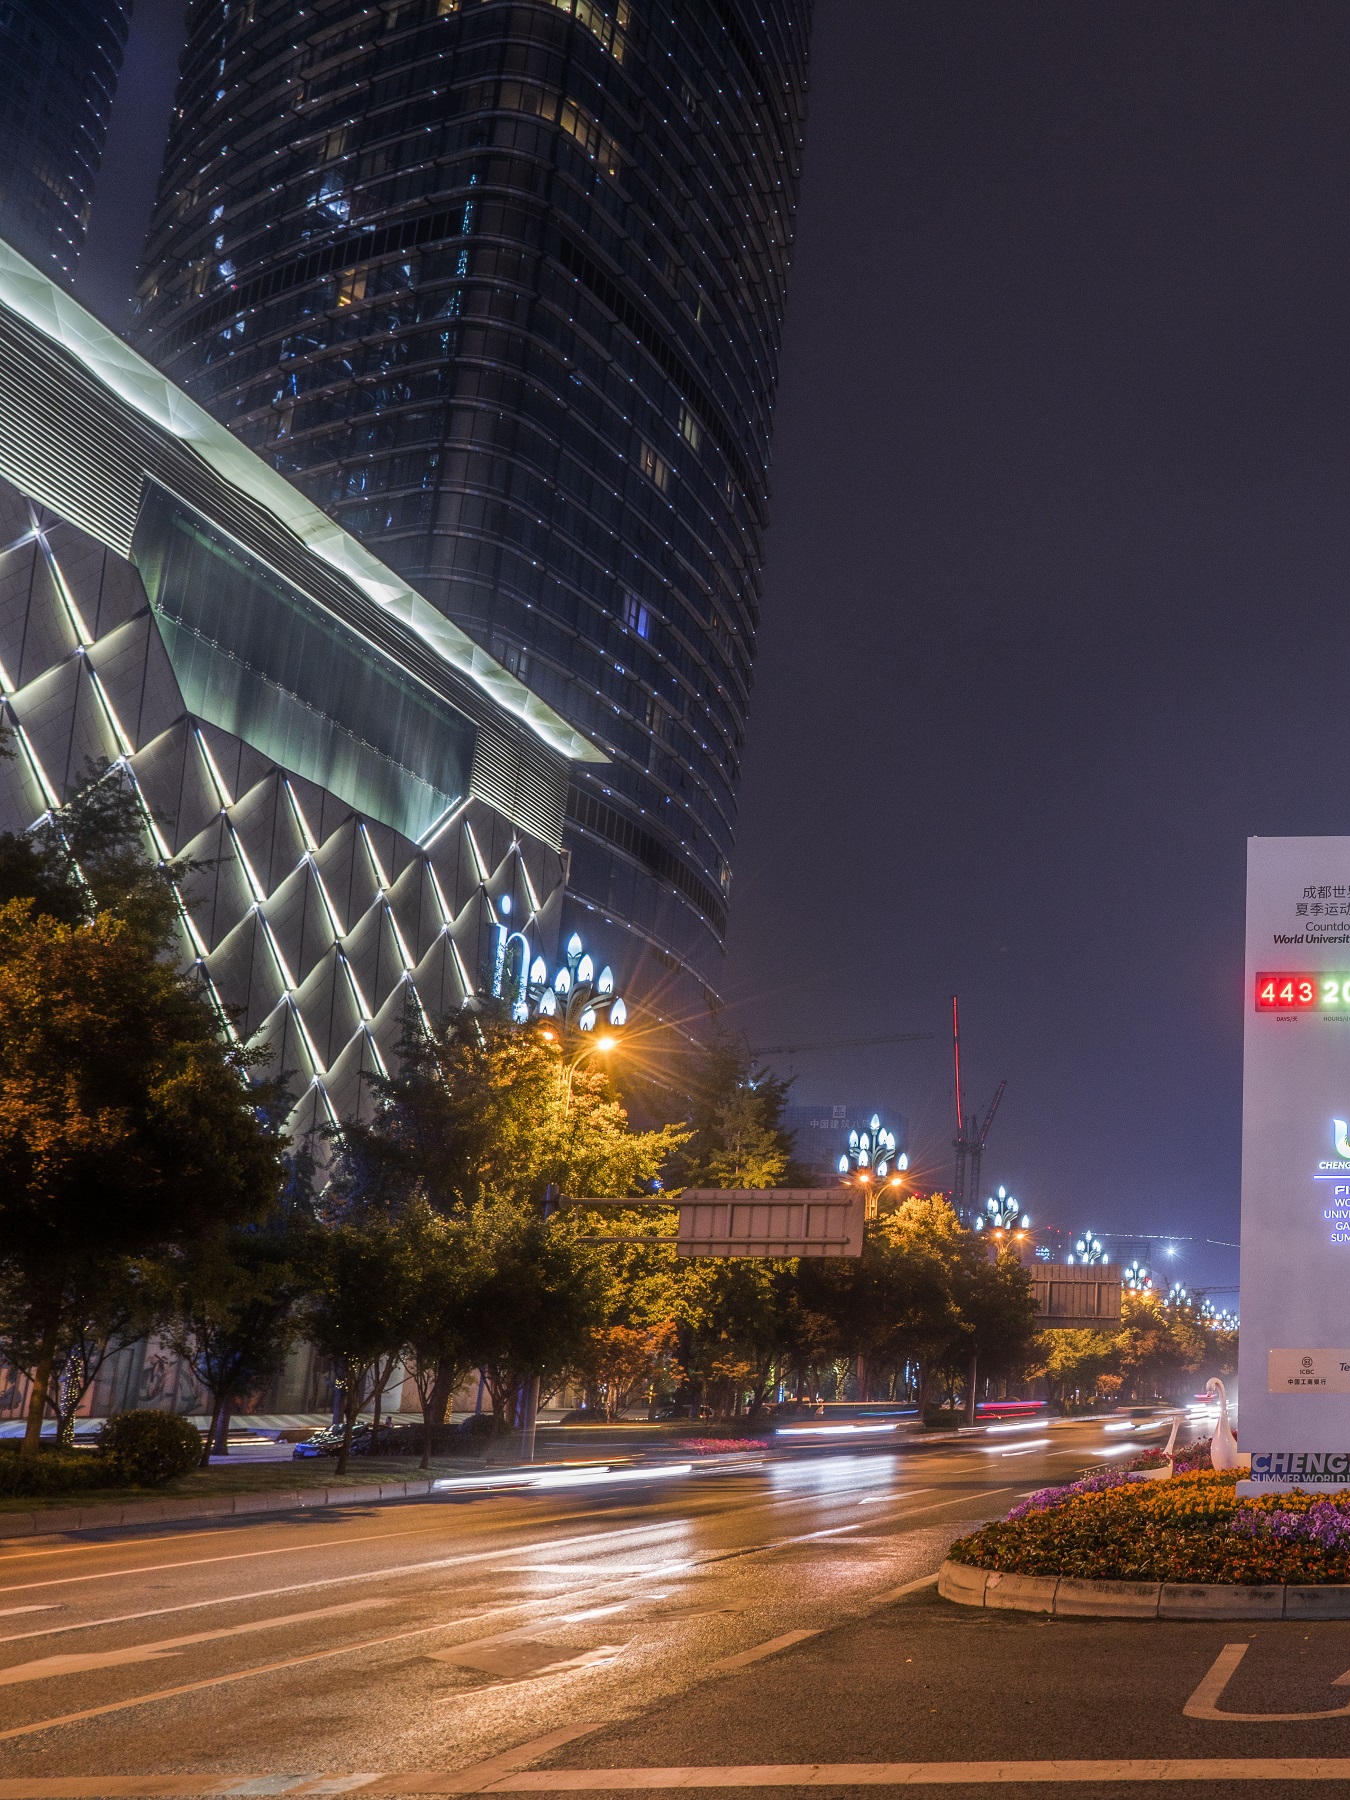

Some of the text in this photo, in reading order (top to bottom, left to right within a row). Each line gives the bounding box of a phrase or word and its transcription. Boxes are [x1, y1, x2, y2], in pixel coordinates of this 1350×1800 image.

[1273, 934, 1304, 944] World
[1261, 982, 1313, 1002] 443
[1287, 1378, 1327, 1386] 中国工商银行
[1251, 1474, 1301, 1482] SUMMER
